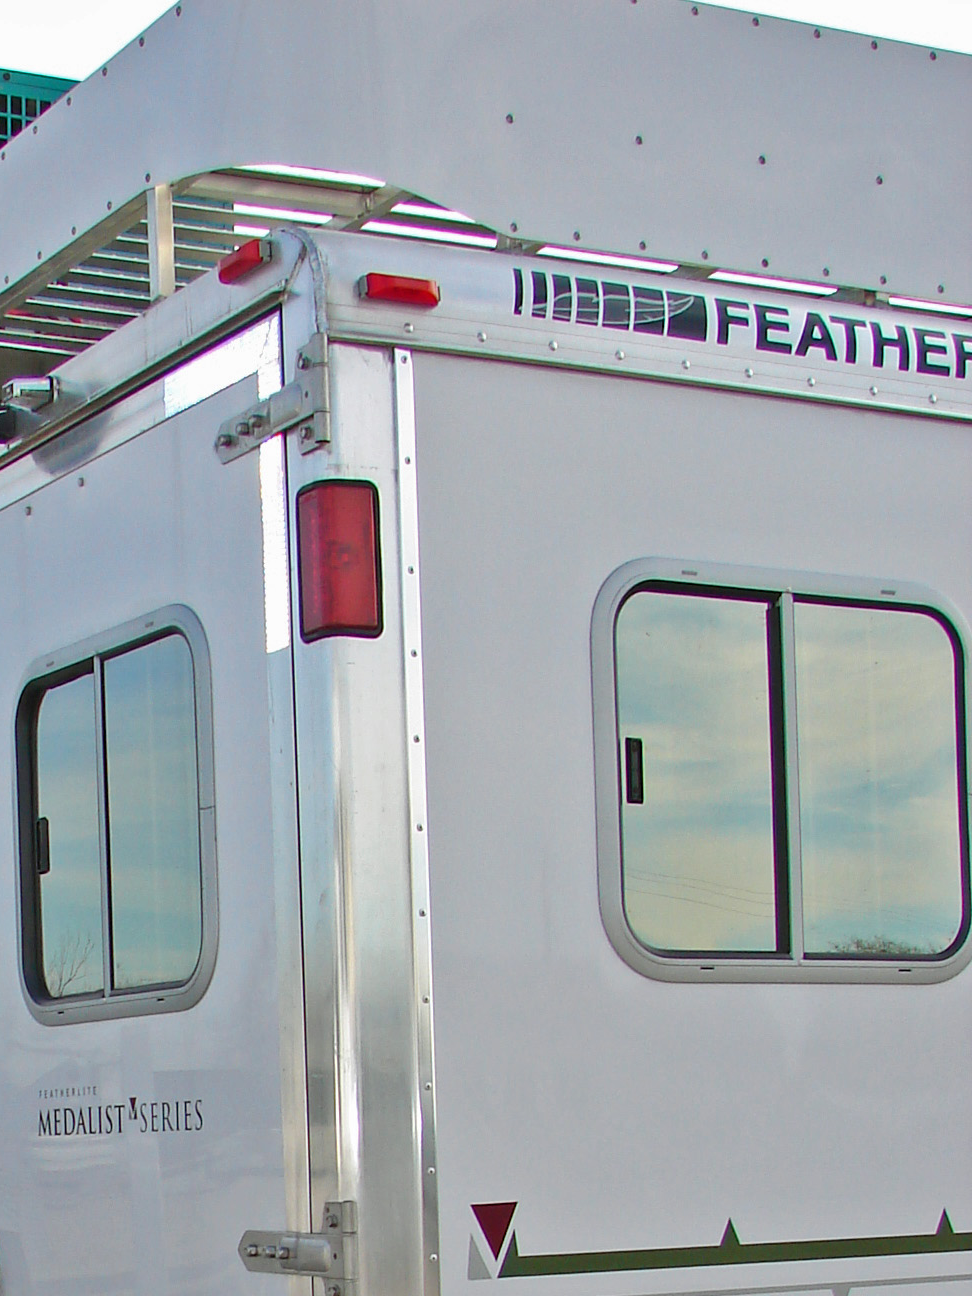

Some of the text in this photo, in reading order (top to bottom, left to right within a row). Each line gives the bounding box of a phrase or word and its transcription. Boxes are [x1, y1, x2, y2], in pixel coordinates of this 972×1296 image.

[38, 1086, 98, 1099] FEATHERLITE
[37, 1099, 204, 1137] MEDALIST SERIES
